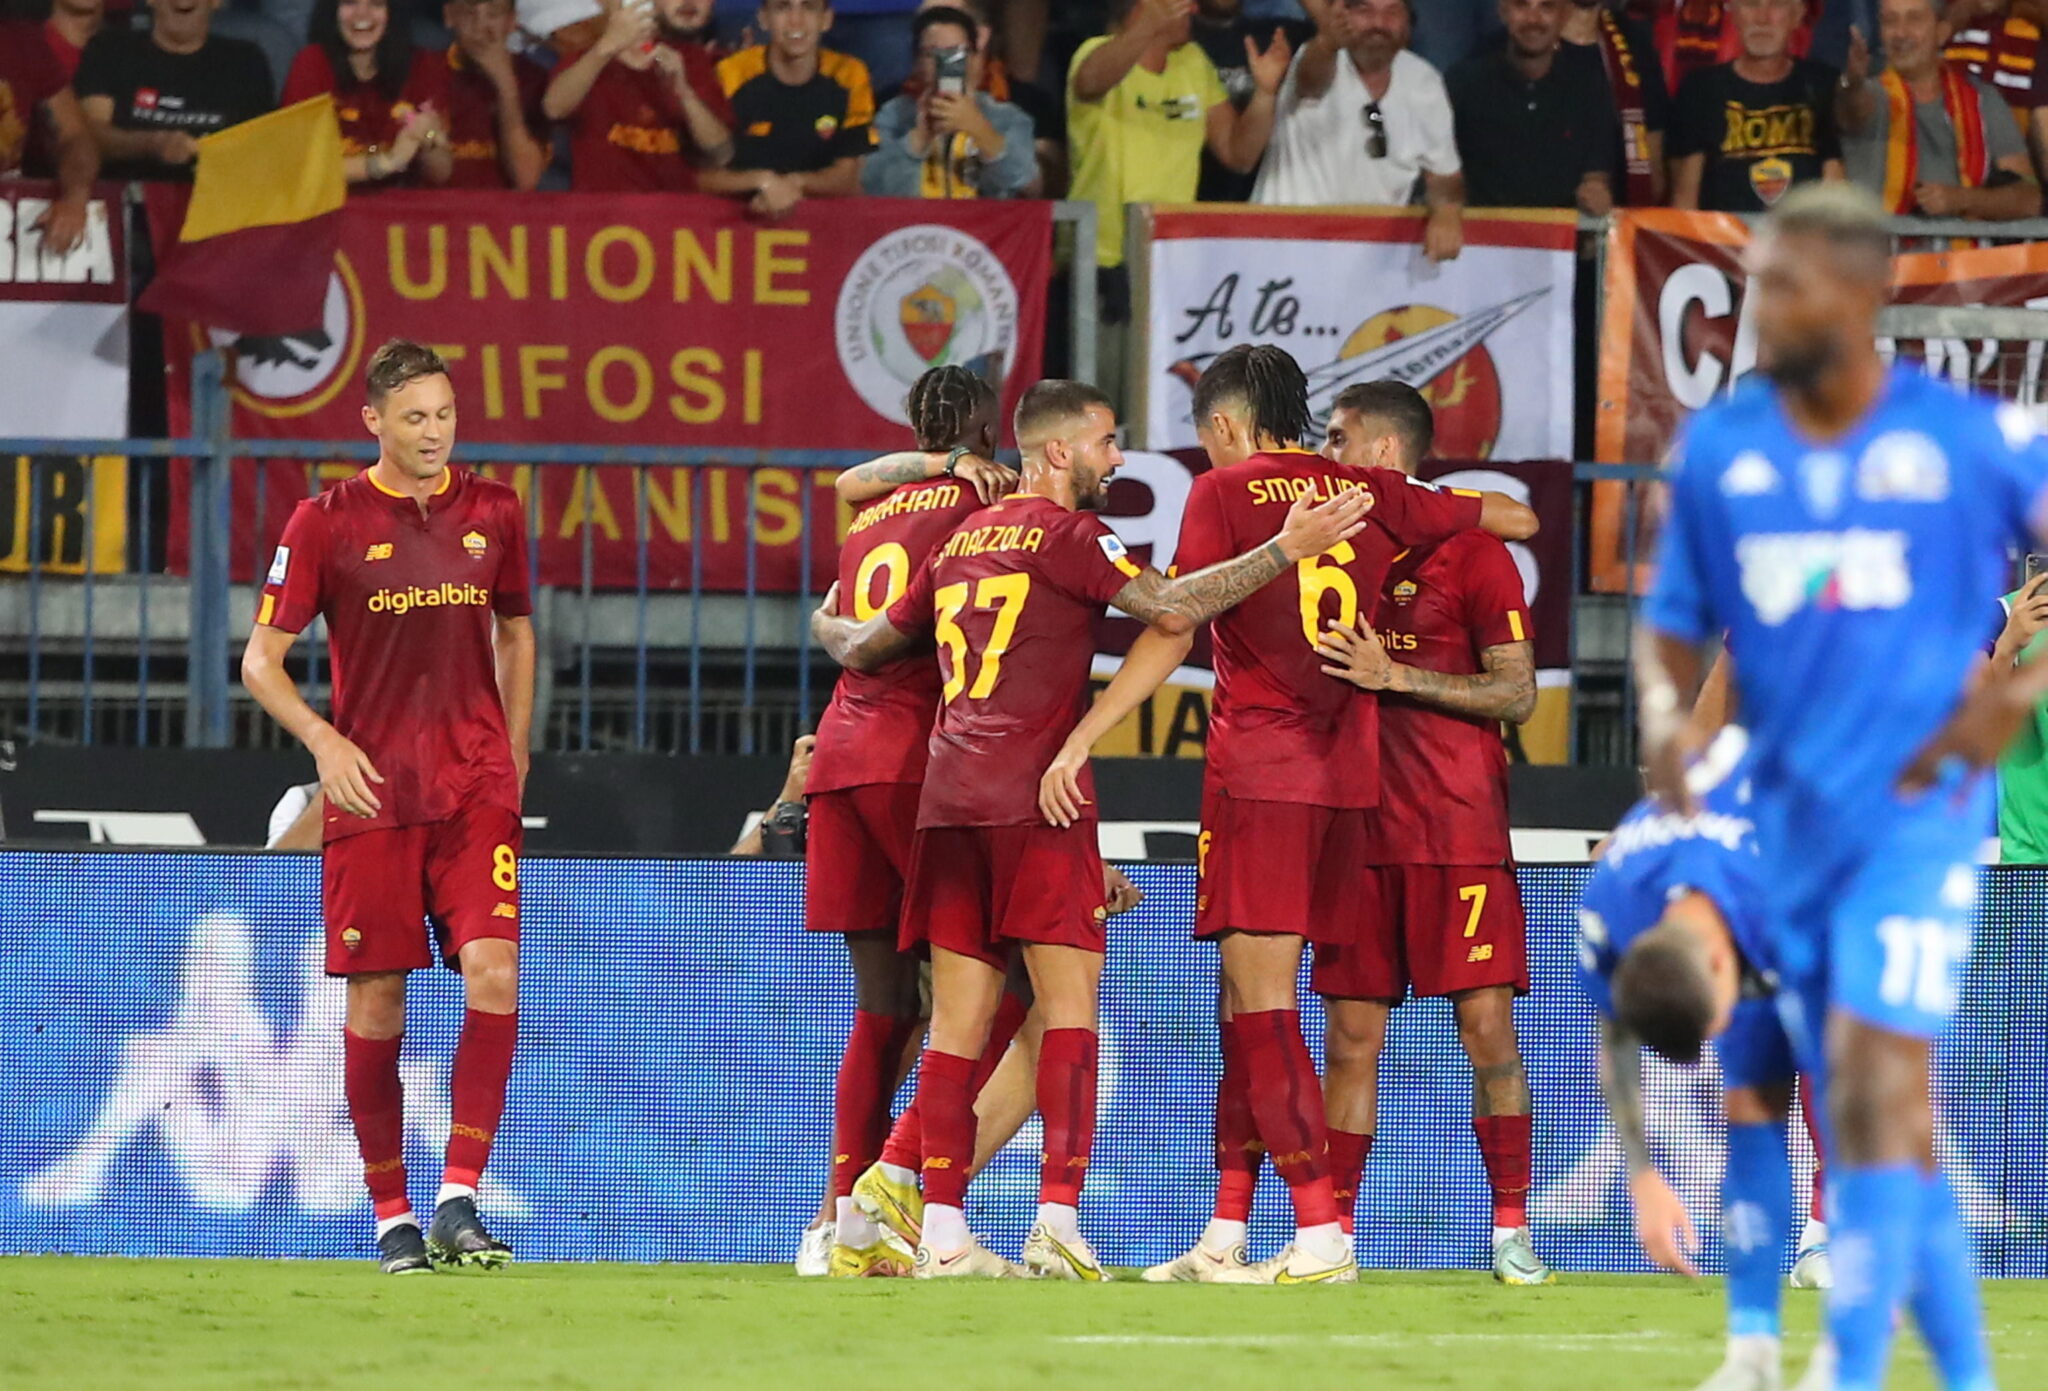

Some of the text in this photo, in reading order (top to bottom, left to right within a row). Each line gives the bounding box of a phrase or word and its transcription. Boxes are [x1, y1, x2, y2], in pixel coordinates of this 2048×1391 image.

[387, 224, 811, 305] UNIONE
[1174, 272, 1241, 344] A
[847, 484, 961, 536] ABRAHAM
[367, 583, 489, 614] digitalbits
[1298, 540, 1357, 651] 6
[934, 572, 1030, 706] 37
[492, 843, 517, 892] 8
[1459, 884, 1488, 938] 7
